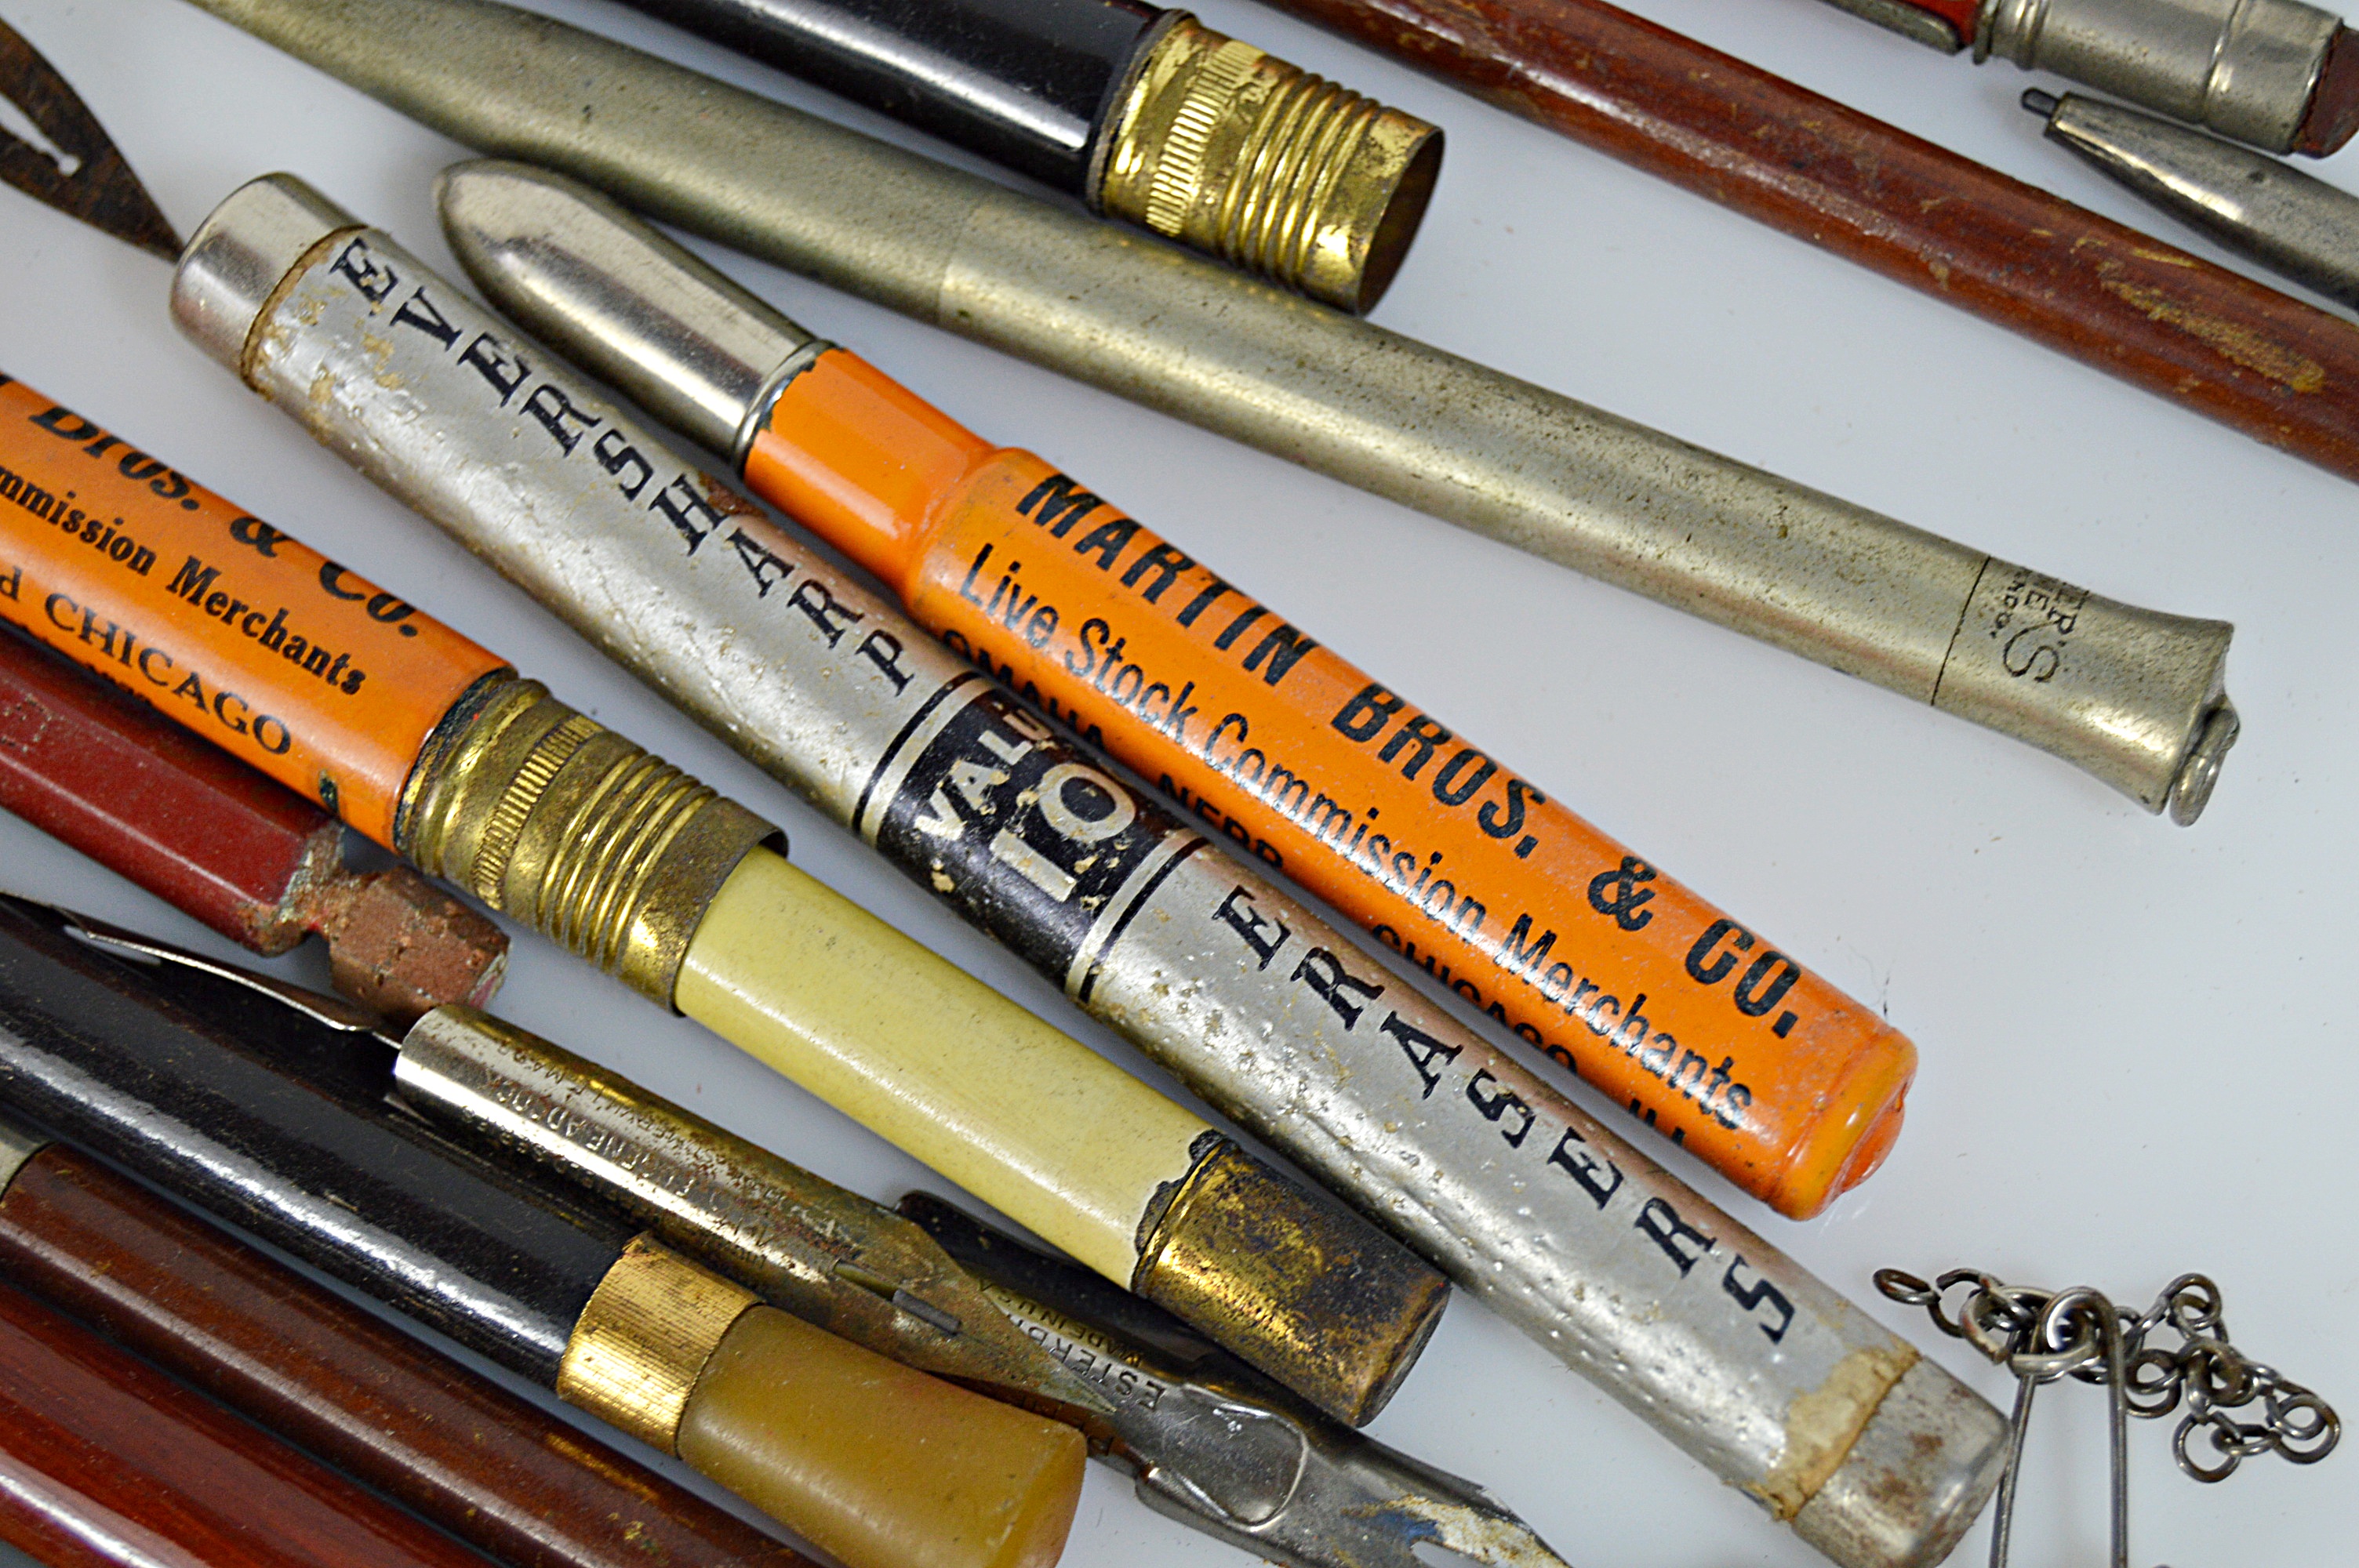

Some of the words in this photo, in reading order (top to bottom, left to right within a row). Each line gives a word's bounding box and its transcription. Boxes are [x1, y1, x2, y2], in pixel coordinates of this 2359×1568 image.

[44, 592, 293, 756] CHICAGO
[165, 554, 368, 696] Merchants
[328, 237, 916, 699] EVERSHARP
[959, 542, 1060, 649] Live
[1065, 616, 1199, 746] Stock
[1204, 712, 1488, 944] Commission
[1492, 913, 1754, 1131] Merchants
[1016, 472, 1319, 688] MARTIN
[1331, 682, 1546, 858] BROS.
[1587, 855, 1657, 932] &
[1684, 919, 1801, 1039] CO.
[1212, 885, 1796, 1345] ERASERS
